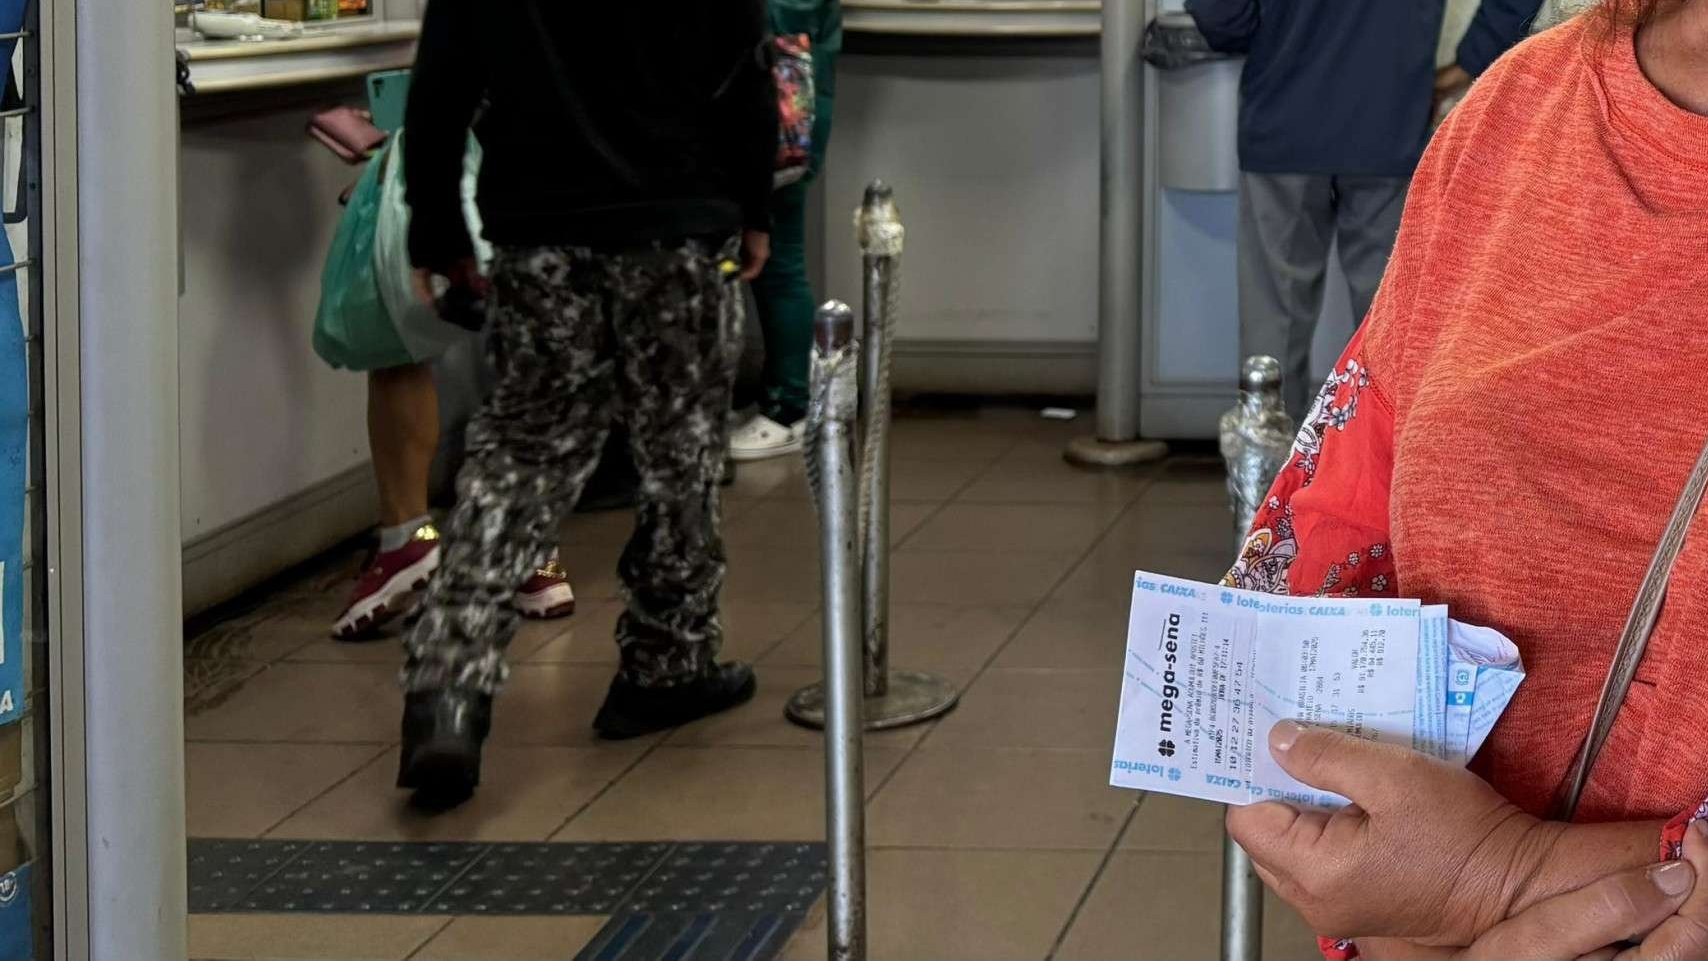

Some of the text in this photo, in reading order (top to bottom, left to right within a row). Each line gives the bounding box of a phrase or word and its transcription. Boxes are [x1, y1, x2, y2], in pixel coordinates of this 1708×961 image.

[1160, 583, 1196, 598] CAIXA
[1309, 605, 1346, 617] CAIXA
[1159, 613, 1181, 733] mega-sena
[1190, 729, 1200, 769] Estimativa
[1113, 760, 1164, 778] loterias
[1205, 773, 1241, 789] CAIXA
